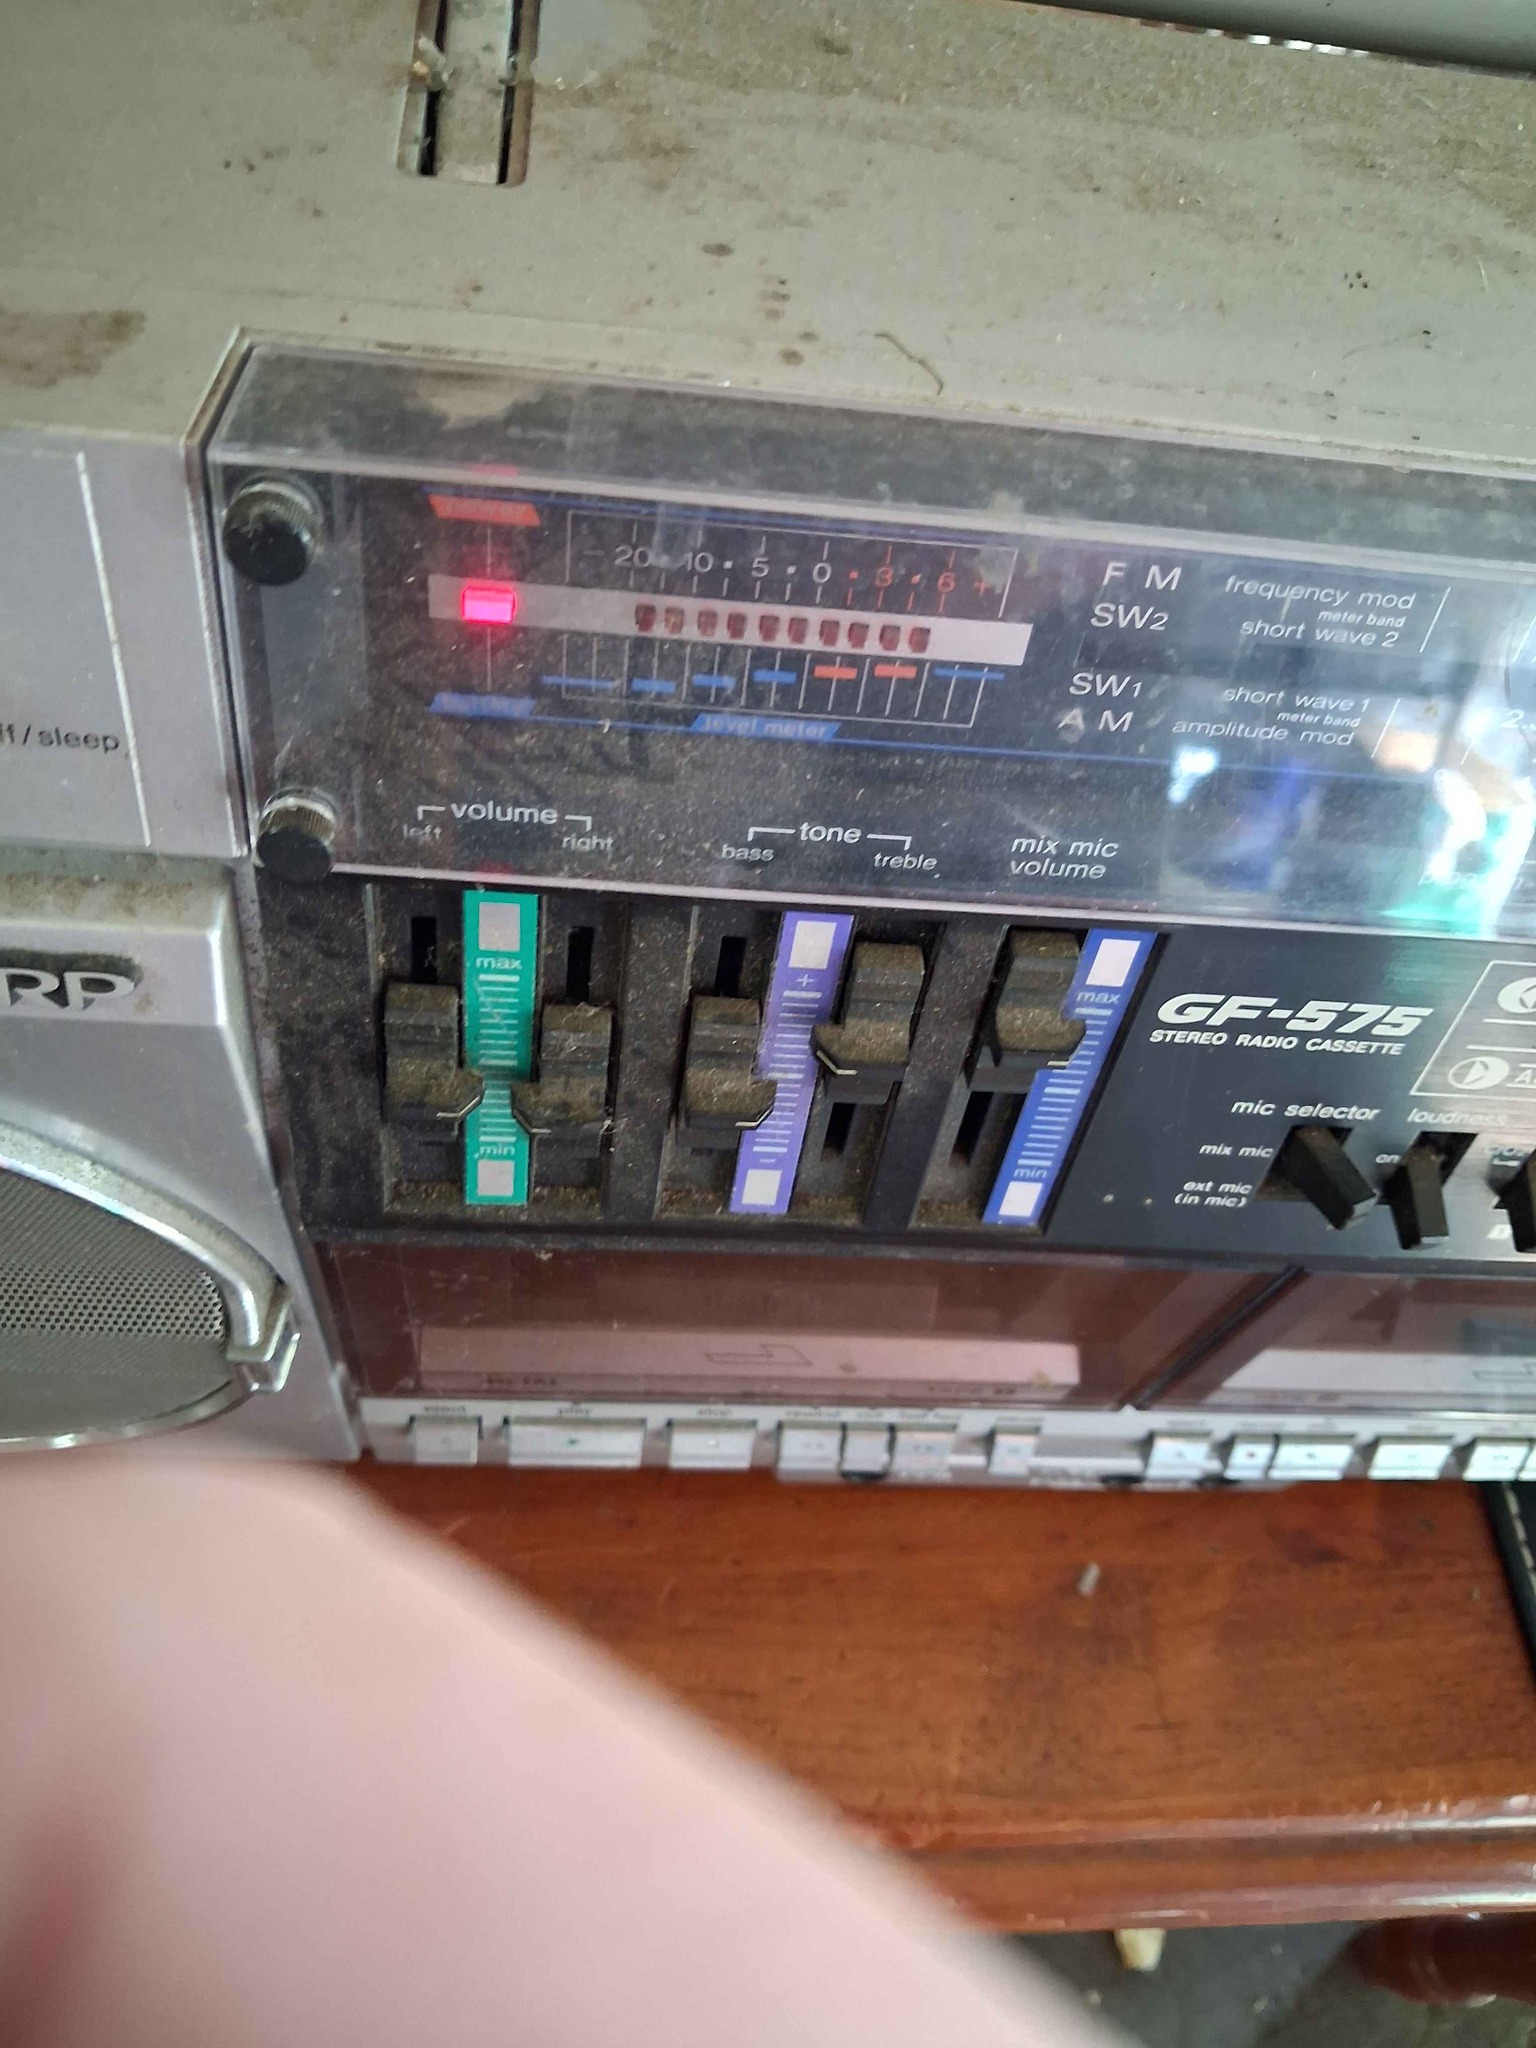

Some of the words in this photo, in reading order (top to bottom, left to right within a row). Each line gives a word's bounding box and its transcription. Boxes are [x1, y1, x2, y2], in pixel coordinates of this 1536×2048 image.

[614, 546, 651, 568] 20
[685, 551, 713, 573] 10
[751, 556, 770, 578] 5
[812, 562, 832, 584] 0
[937, 572, 956, 593] 6
[1225, 575, 1350, 607] frequency
[1357, 593, 1416, 610] mod
[1317, 610, 1364, 624] meter
[1366, 612, 1407, 628] band
[1240, 619, 1306, 640] short
[1315, 628, 1377, 646] wave
[1381, 631, 1400, 648] 2
[1223, 687, 1285, 706] short
[1295, 694, 1354, 713] wave
[1276, 712, 1321, 724] meter
[1322, 714, 1361, 729] band
[1171, 720, 1289, 742] amplitude
[1299, 731, 1355, 747] mod
[450, 800, 559, 825] volume
[799, 821, 862, 844] tone
[562, 833, 614, 856] right
[721, 843, 774, 862] bass
[1011, 835, 1060, 855] mix
[1068, 838, 1119, 858] mic
[873, 852, 938, 871] treble
[1010, 857, 1106, 879] volume
[475, 956, 523, 971] max
[1076, 990, 1121, 1006] max
[1157, 993, 1434, 1037] GF-575
[1149, 1029, 1228, 1046] STEREO
[1235, 1033, 1299, 1050] RADIO
[1305, 1037, 1405, 1056] CASSETTE
[1230, 1099, 1277, 1116] mic
[1284, 1102, 1381, 1121] selector
[1407, 1107, 1508, 1126] loudness
[477, 1143, 516, 1157] min
[1200, 1143, 1233, 1156] mix
[1238, 1145, 1274, 1158] mic
[1375, 1153, 1401, 1164] on
[1013, 1166, 1048, 1179] min
[1183, 1180, 1213, 1193] ext
[1218, 1182, 1253, 1195] mic
[1174, 1193, 1200, 1205] (in
[1204, 1195, 1248, 1209] mic)
